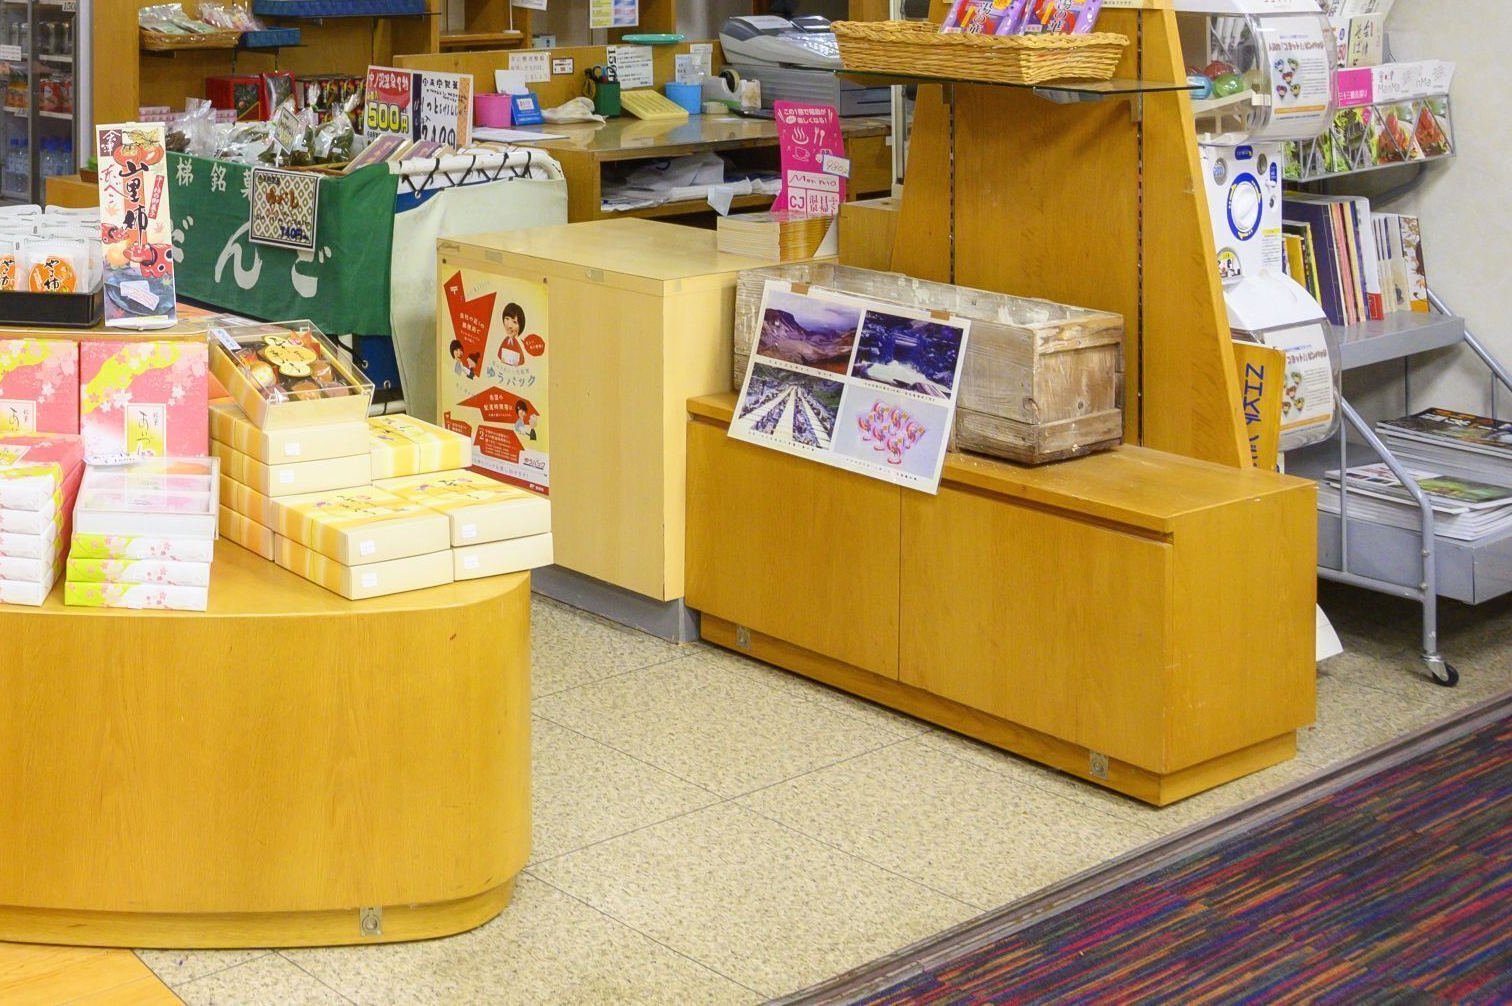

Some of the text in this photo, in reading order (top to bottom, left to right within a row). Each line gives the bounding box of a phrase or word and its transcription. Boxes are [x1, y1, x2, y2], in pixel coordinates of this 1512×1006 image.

[367, 101, 409, 134] 500円
[789, 195, 805, 210] CJ
[486, 366, 536, 387] ゆうパック
[479, 430, 484, 440] 2
[523, 457, 546, 469] ゆうパック
